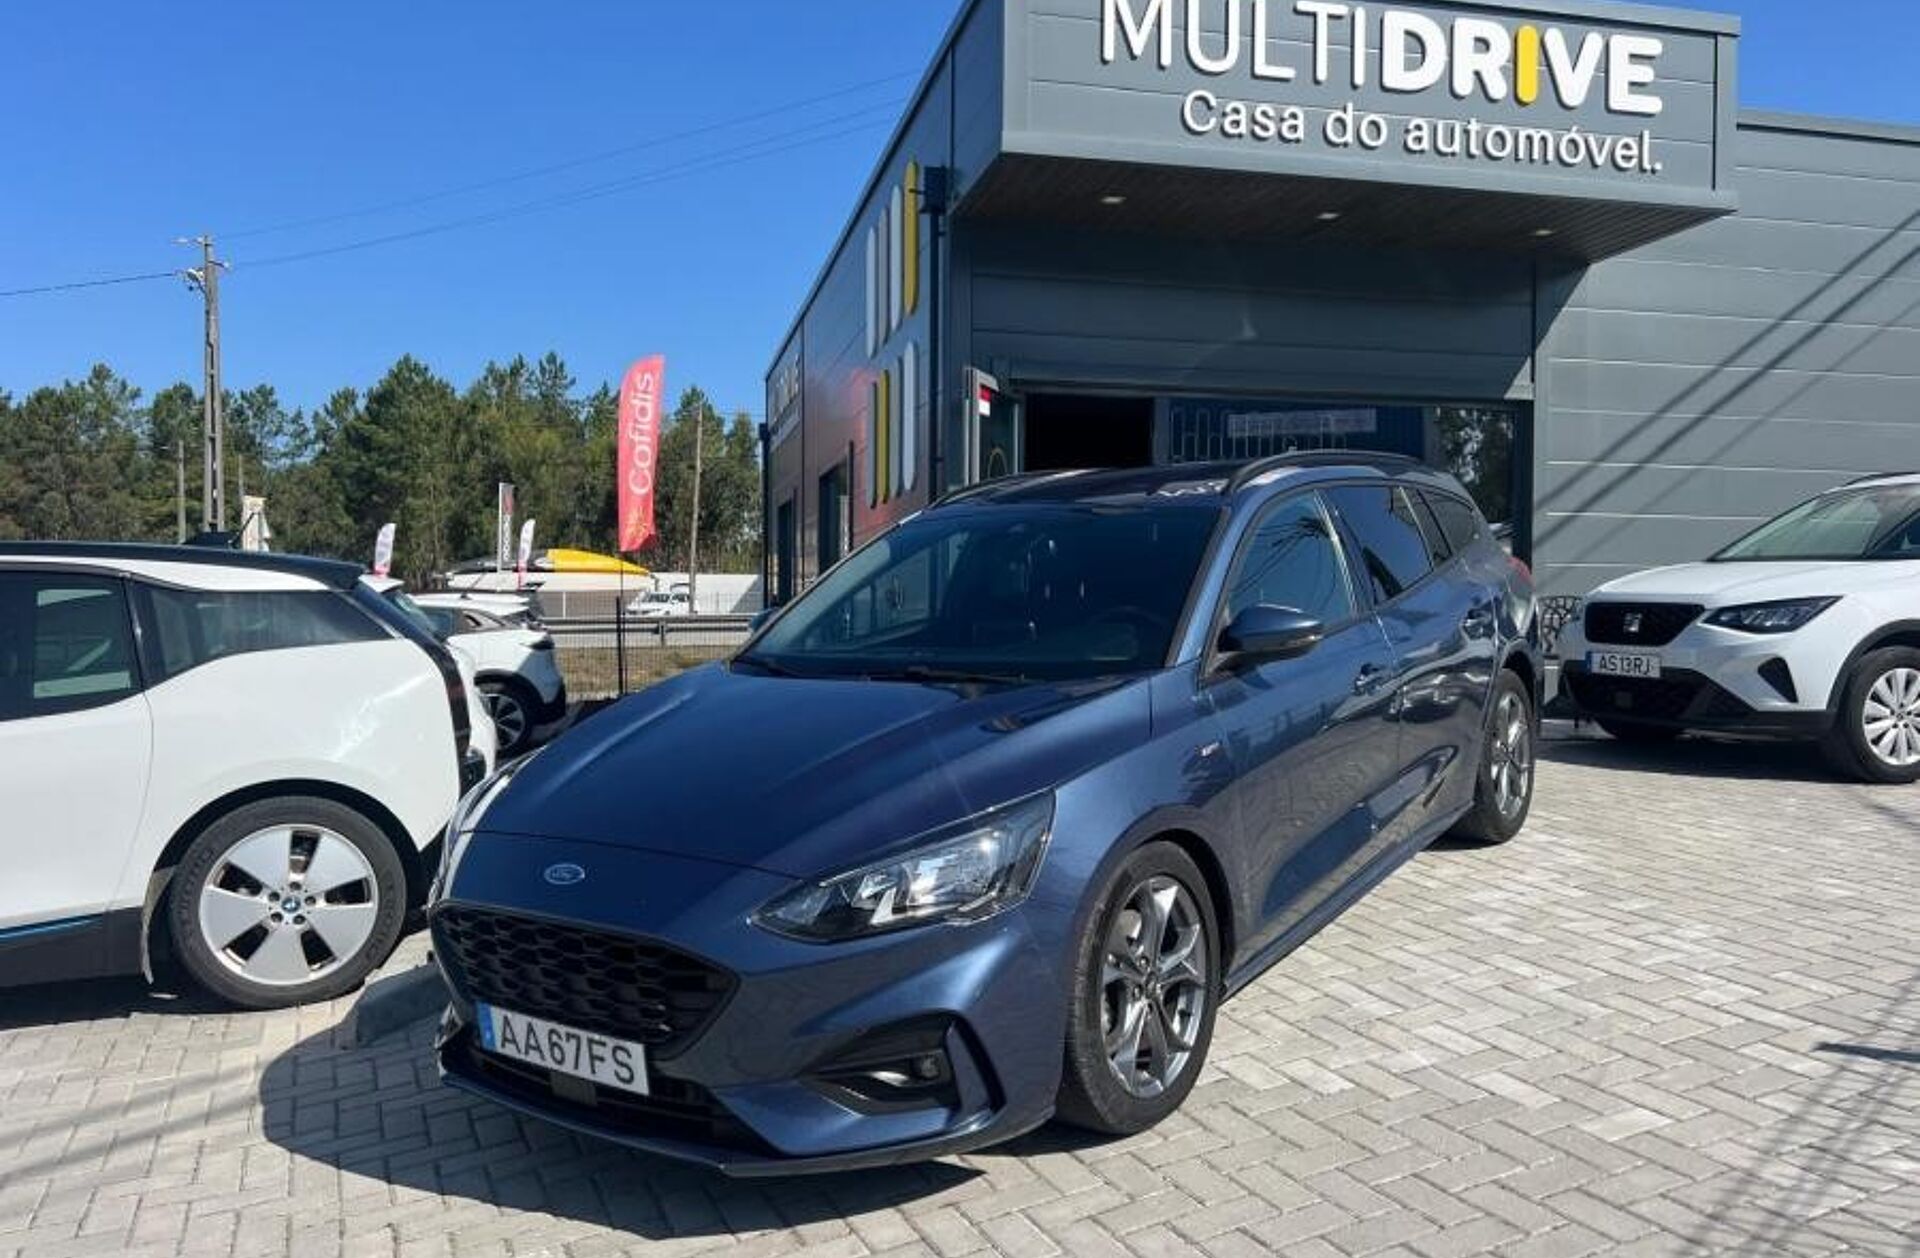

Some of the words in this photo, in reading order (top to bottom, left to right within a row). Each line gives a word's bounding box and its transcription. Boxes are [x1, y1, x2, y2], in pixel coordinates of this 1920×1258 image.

[1101, 0, 1663, 114] MULTIDRIVE
[1183, 90, 1304, 140] Casa
[1323, 102, 1388, 147] do
[1404, 116, 1663, 172] automóvel.
[629, 372, 654, 495] Cofidis
[500, 1015, 635, 1085] AA67FS
